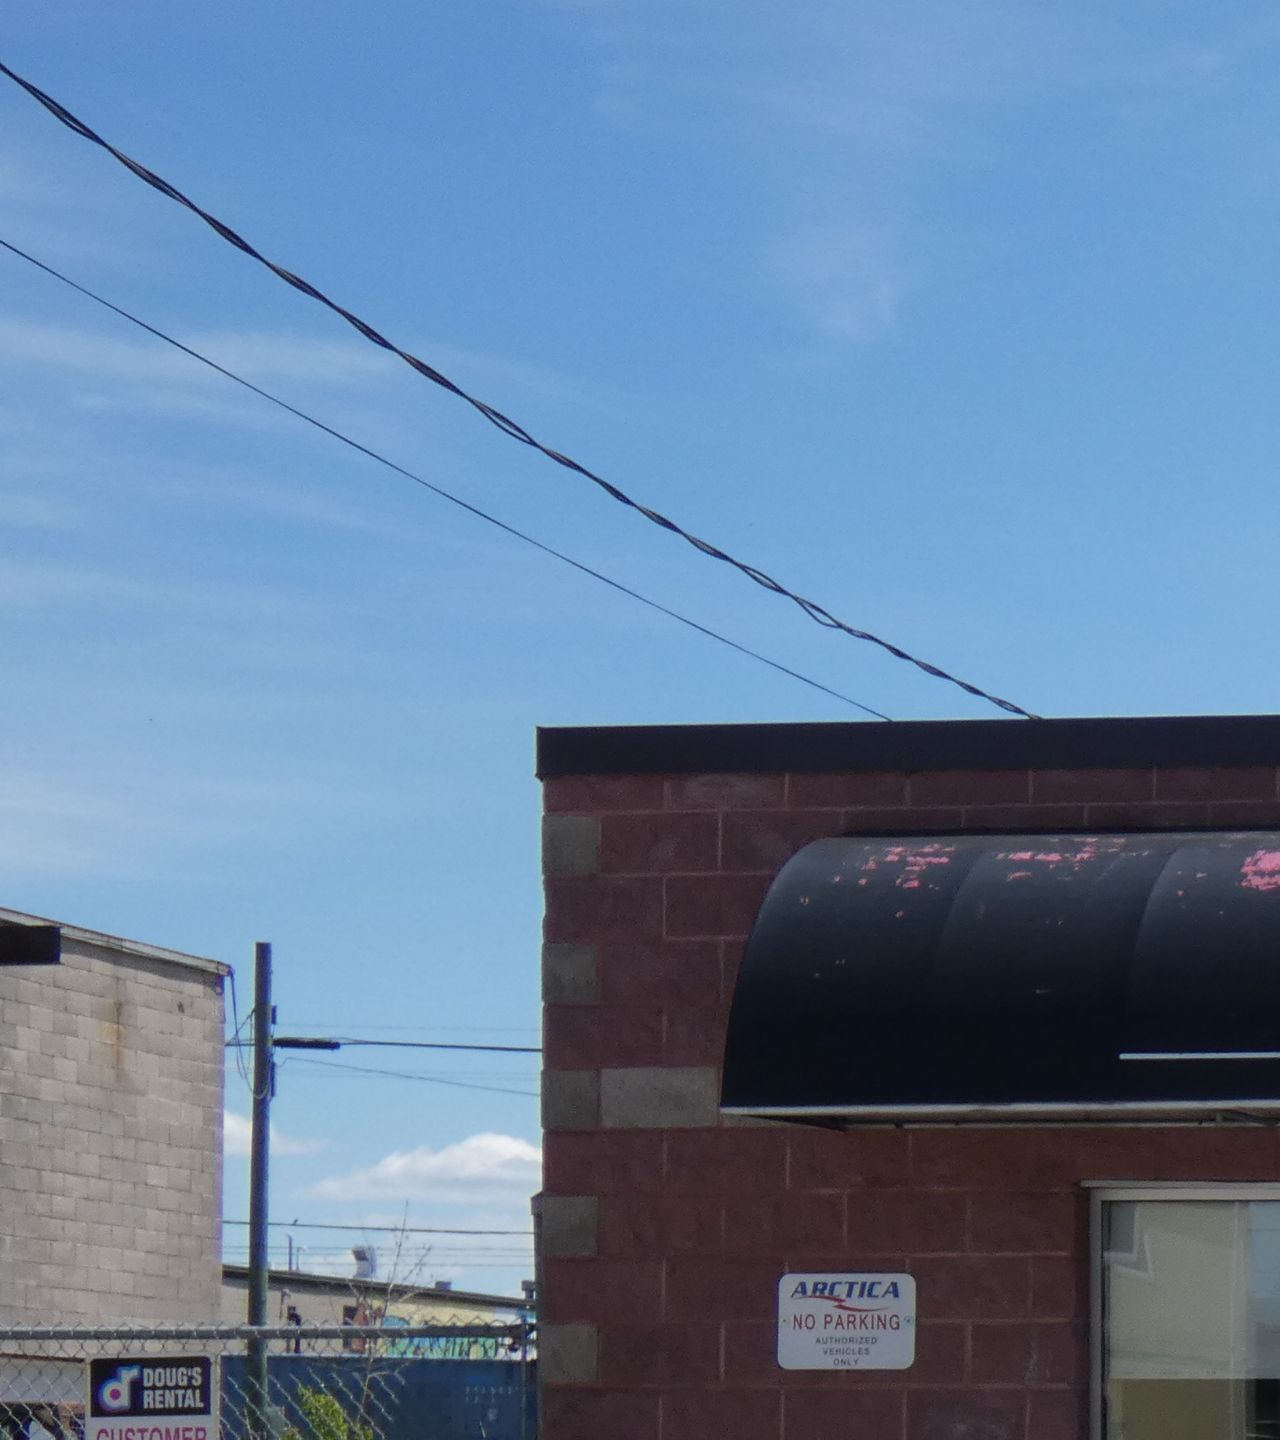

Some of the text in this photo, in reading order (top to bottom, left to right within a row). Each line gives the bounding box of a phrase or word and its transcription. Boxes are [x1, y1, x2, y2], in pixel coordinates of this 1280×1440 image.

[790, 1281, 900, 1299] ARCTICA
[793, 1314, 901, 1331] NO PARKING
[815, 1336, 878, 1345] AUTHORIZED
[823, 1347, 871, 1356] VEHICLES
[833, 1358, 860, 1366] ONLY
[143, 1366, 202, 1388] DOUG'S
[143, 1389, 204, 1410] RENTAL
